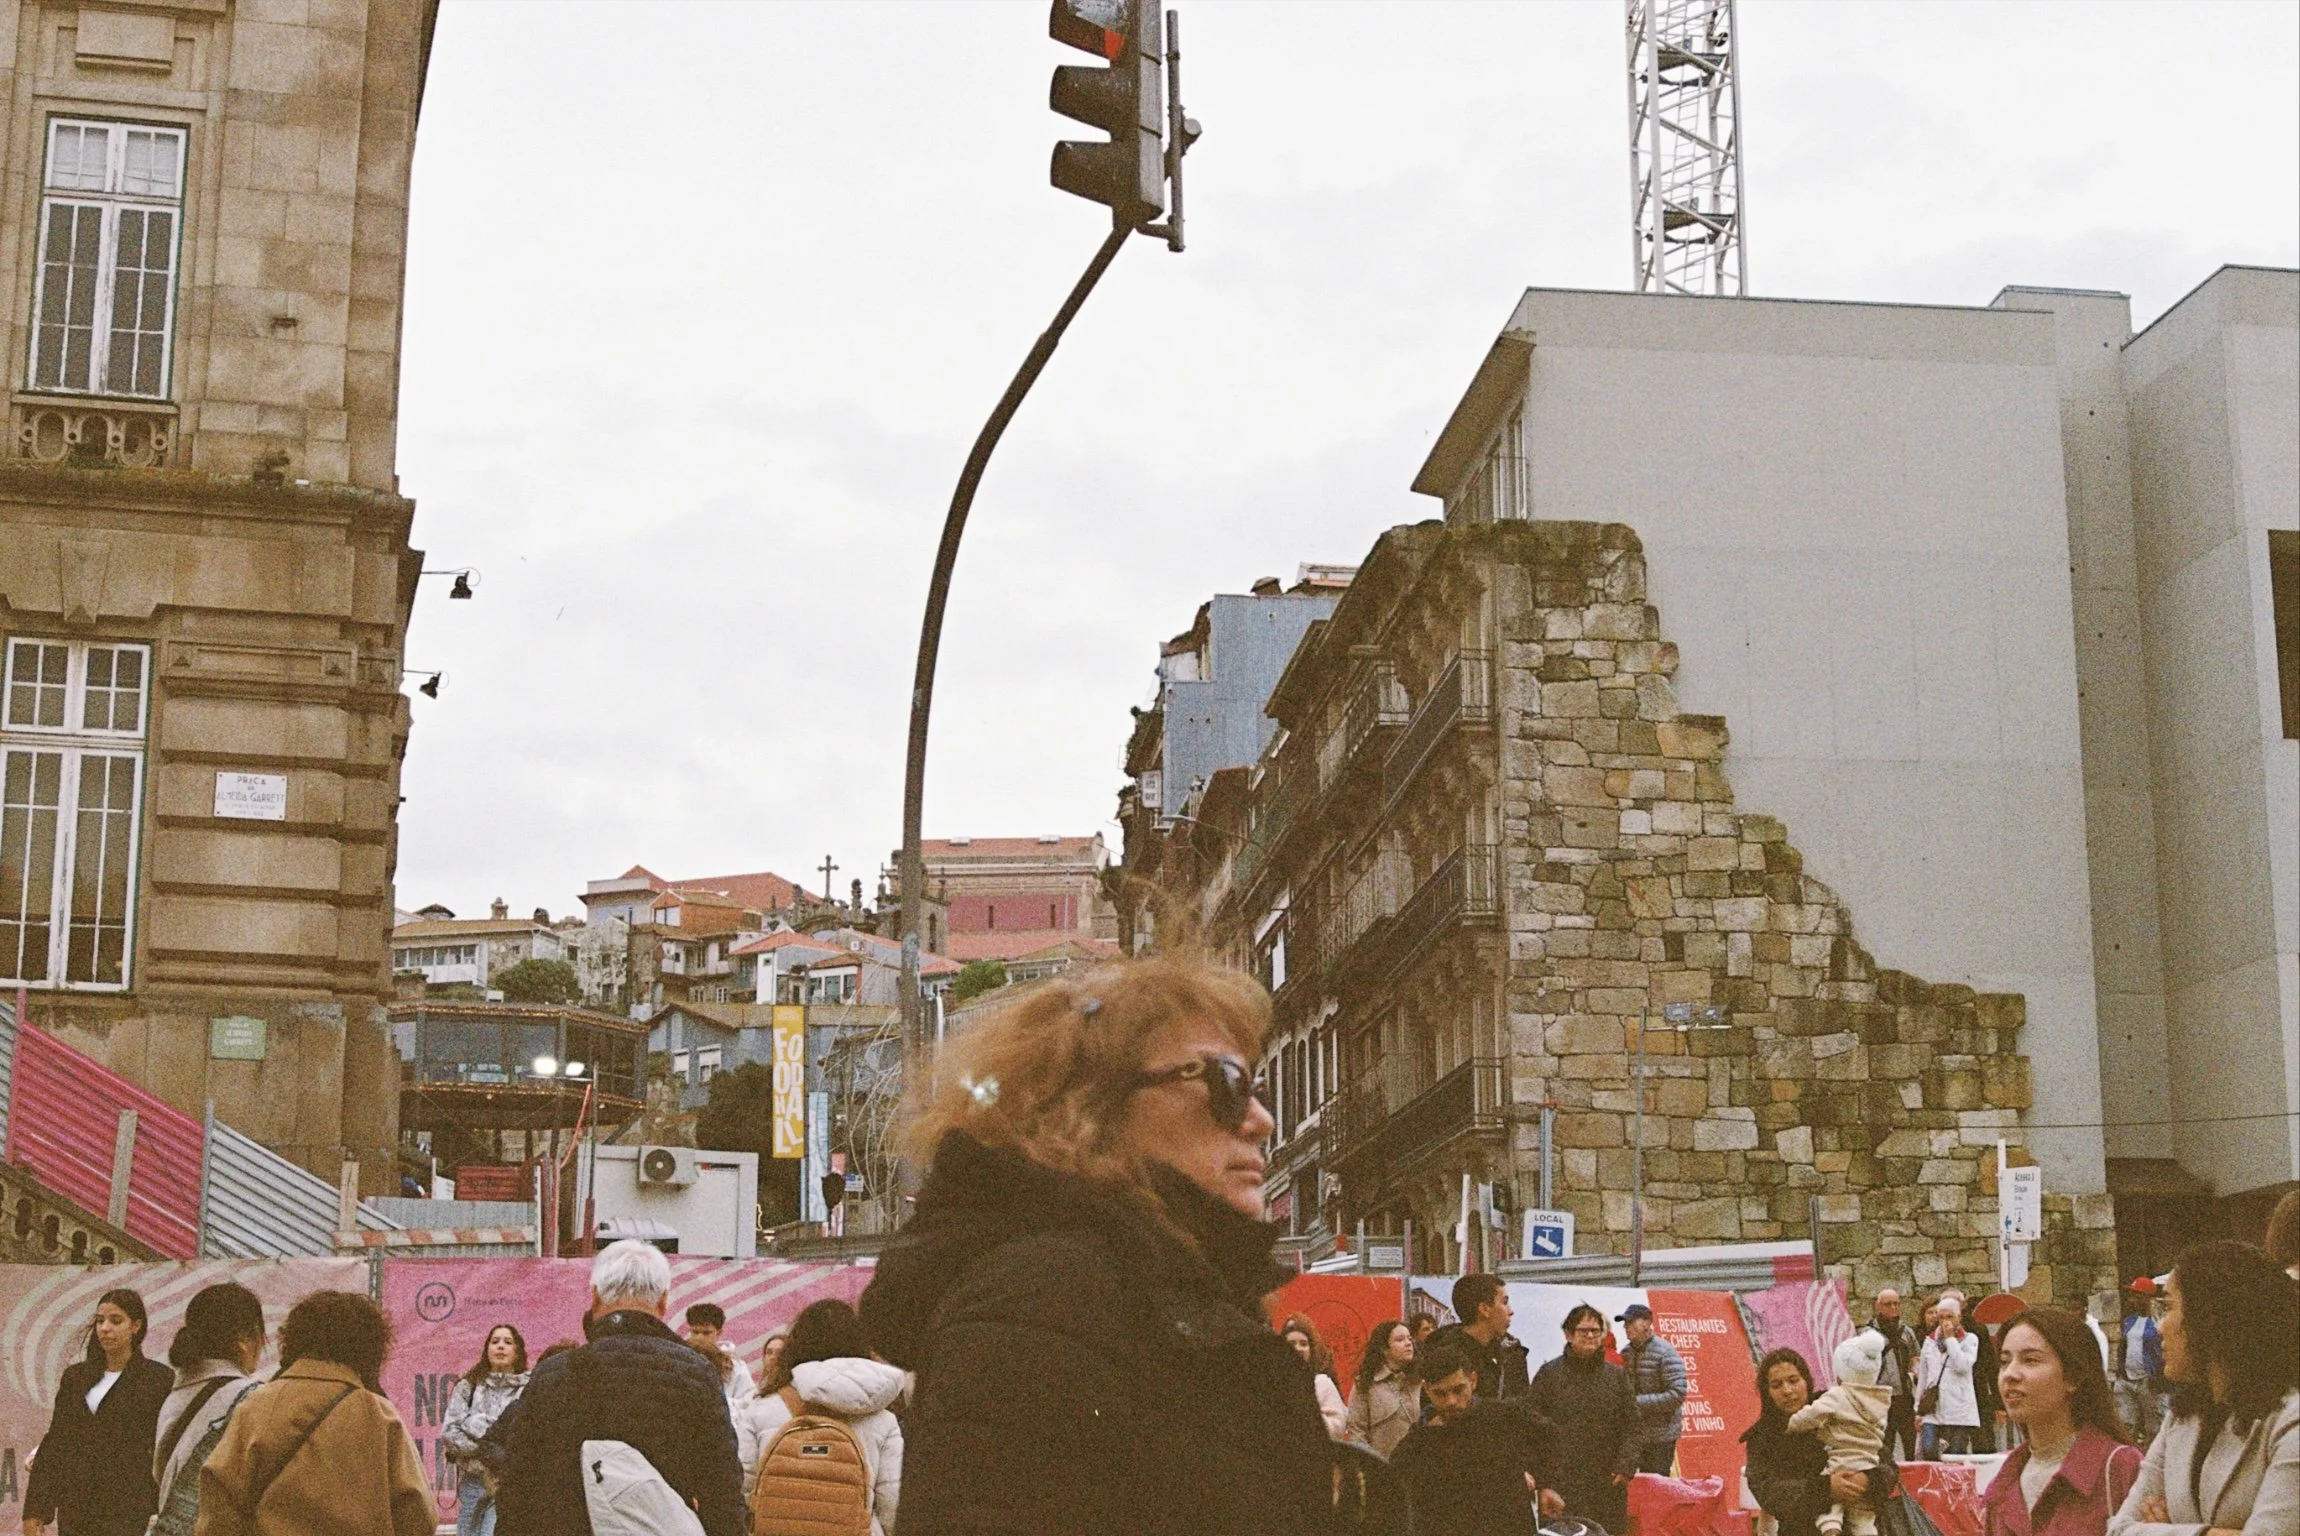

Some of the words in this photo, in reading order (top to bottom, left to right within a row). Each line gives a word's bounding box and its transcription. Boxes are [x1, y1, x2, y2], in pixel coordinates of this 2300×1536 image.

[1534, 1214, 1564, 1224] LOCAL
[1658, 1318, 1728, 1334] RESTAURANTES
[1670, 1333, 1701, 1349] CHEFS
[1692, 1416, 1725, 1431] VINHO
